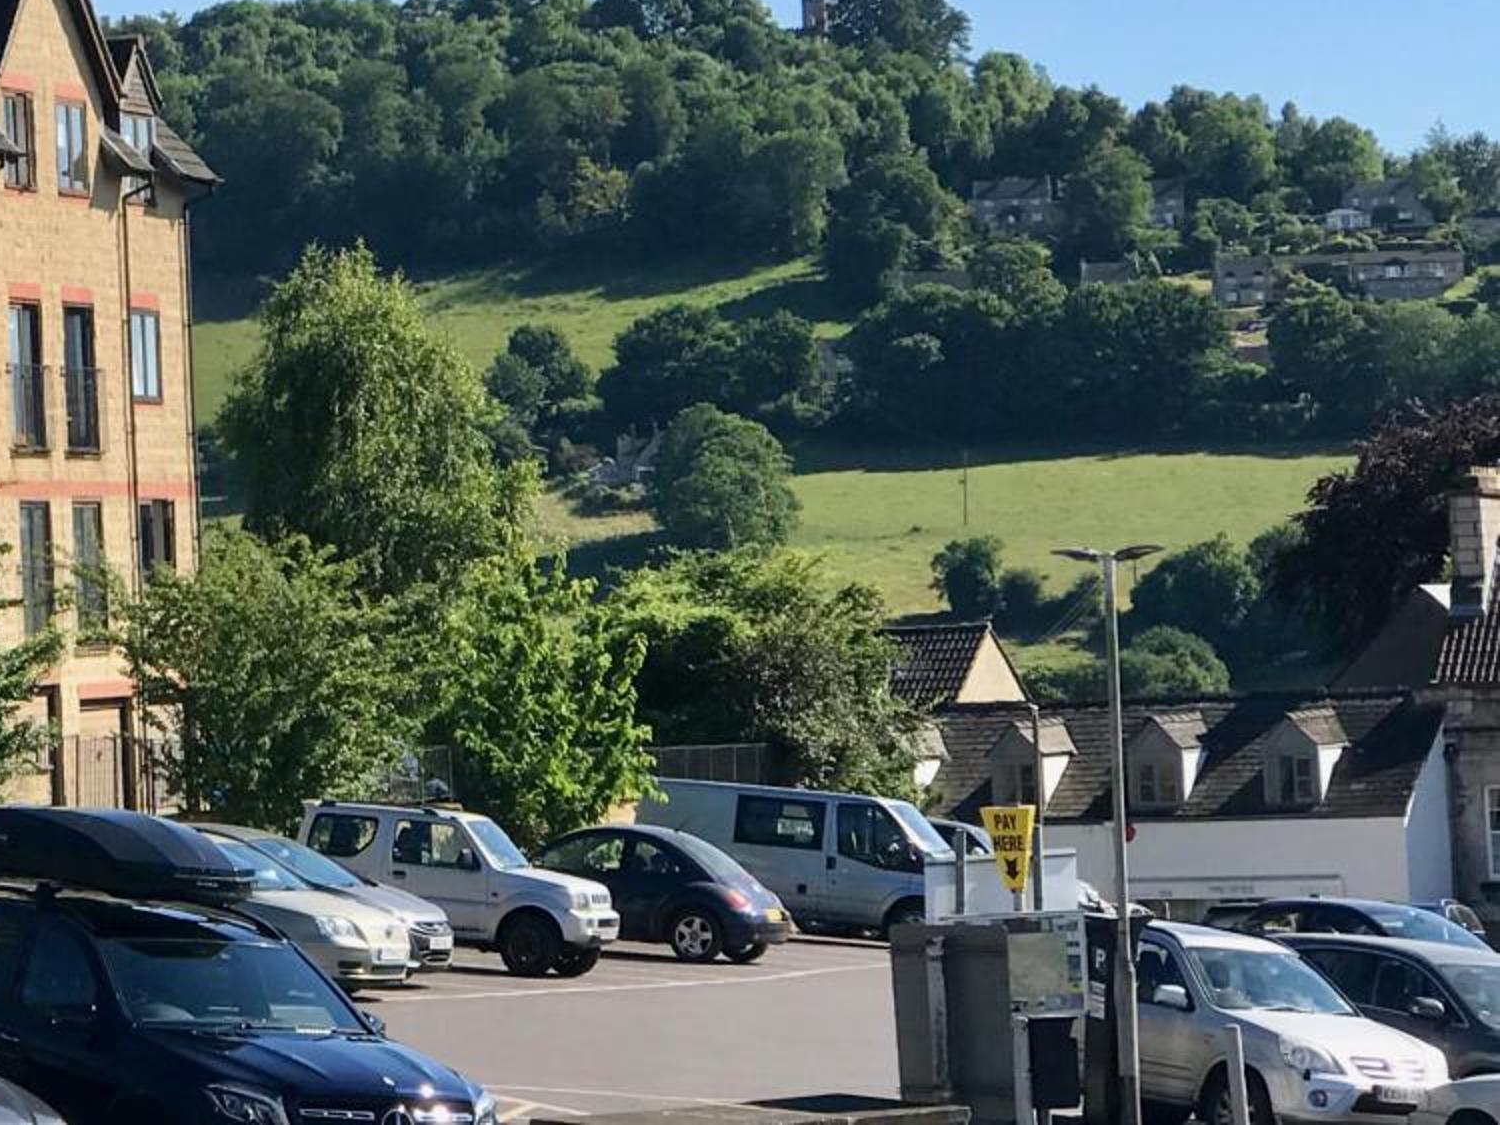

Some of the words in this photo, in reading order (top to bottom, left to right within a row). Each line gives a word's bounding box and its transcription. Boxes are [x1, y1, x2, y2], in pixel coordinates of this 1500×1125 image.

[994, 814, 1016, 830] PAY
[993, 835, 1025, 851] HERE
[1095, 948, 1106, 968] P
